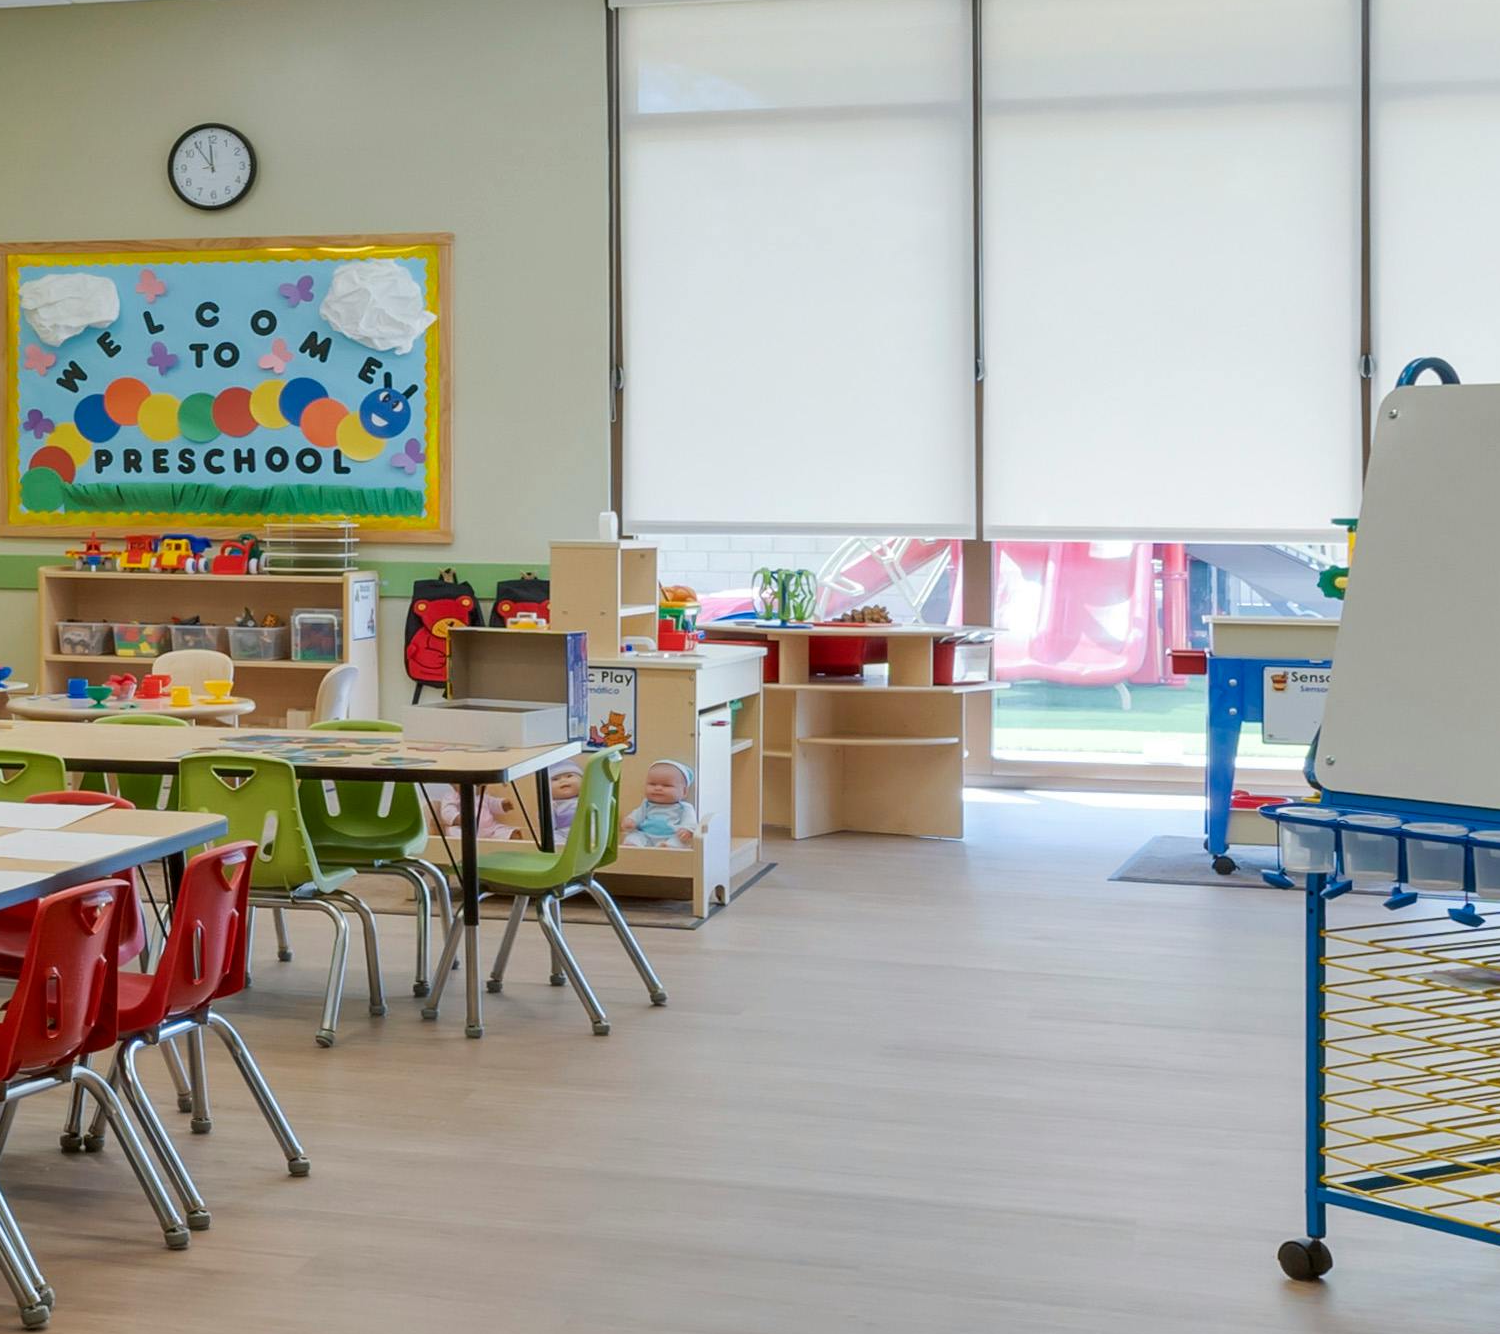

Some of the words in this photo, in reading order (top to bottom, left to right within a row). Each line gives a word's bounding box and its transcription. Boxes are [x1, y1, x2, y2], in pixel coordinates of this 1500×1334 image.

[233, 148, 241, 156] 2
[181, 164, 187, 173] 9
[239, 162, 246, 170] 3
[55, 301, 383, 394] WELCOME
[190, 342, 240, 368] TO
[94, 446, 351, 475] PRESCHOOL
[601, 671, 633, 686] Play
